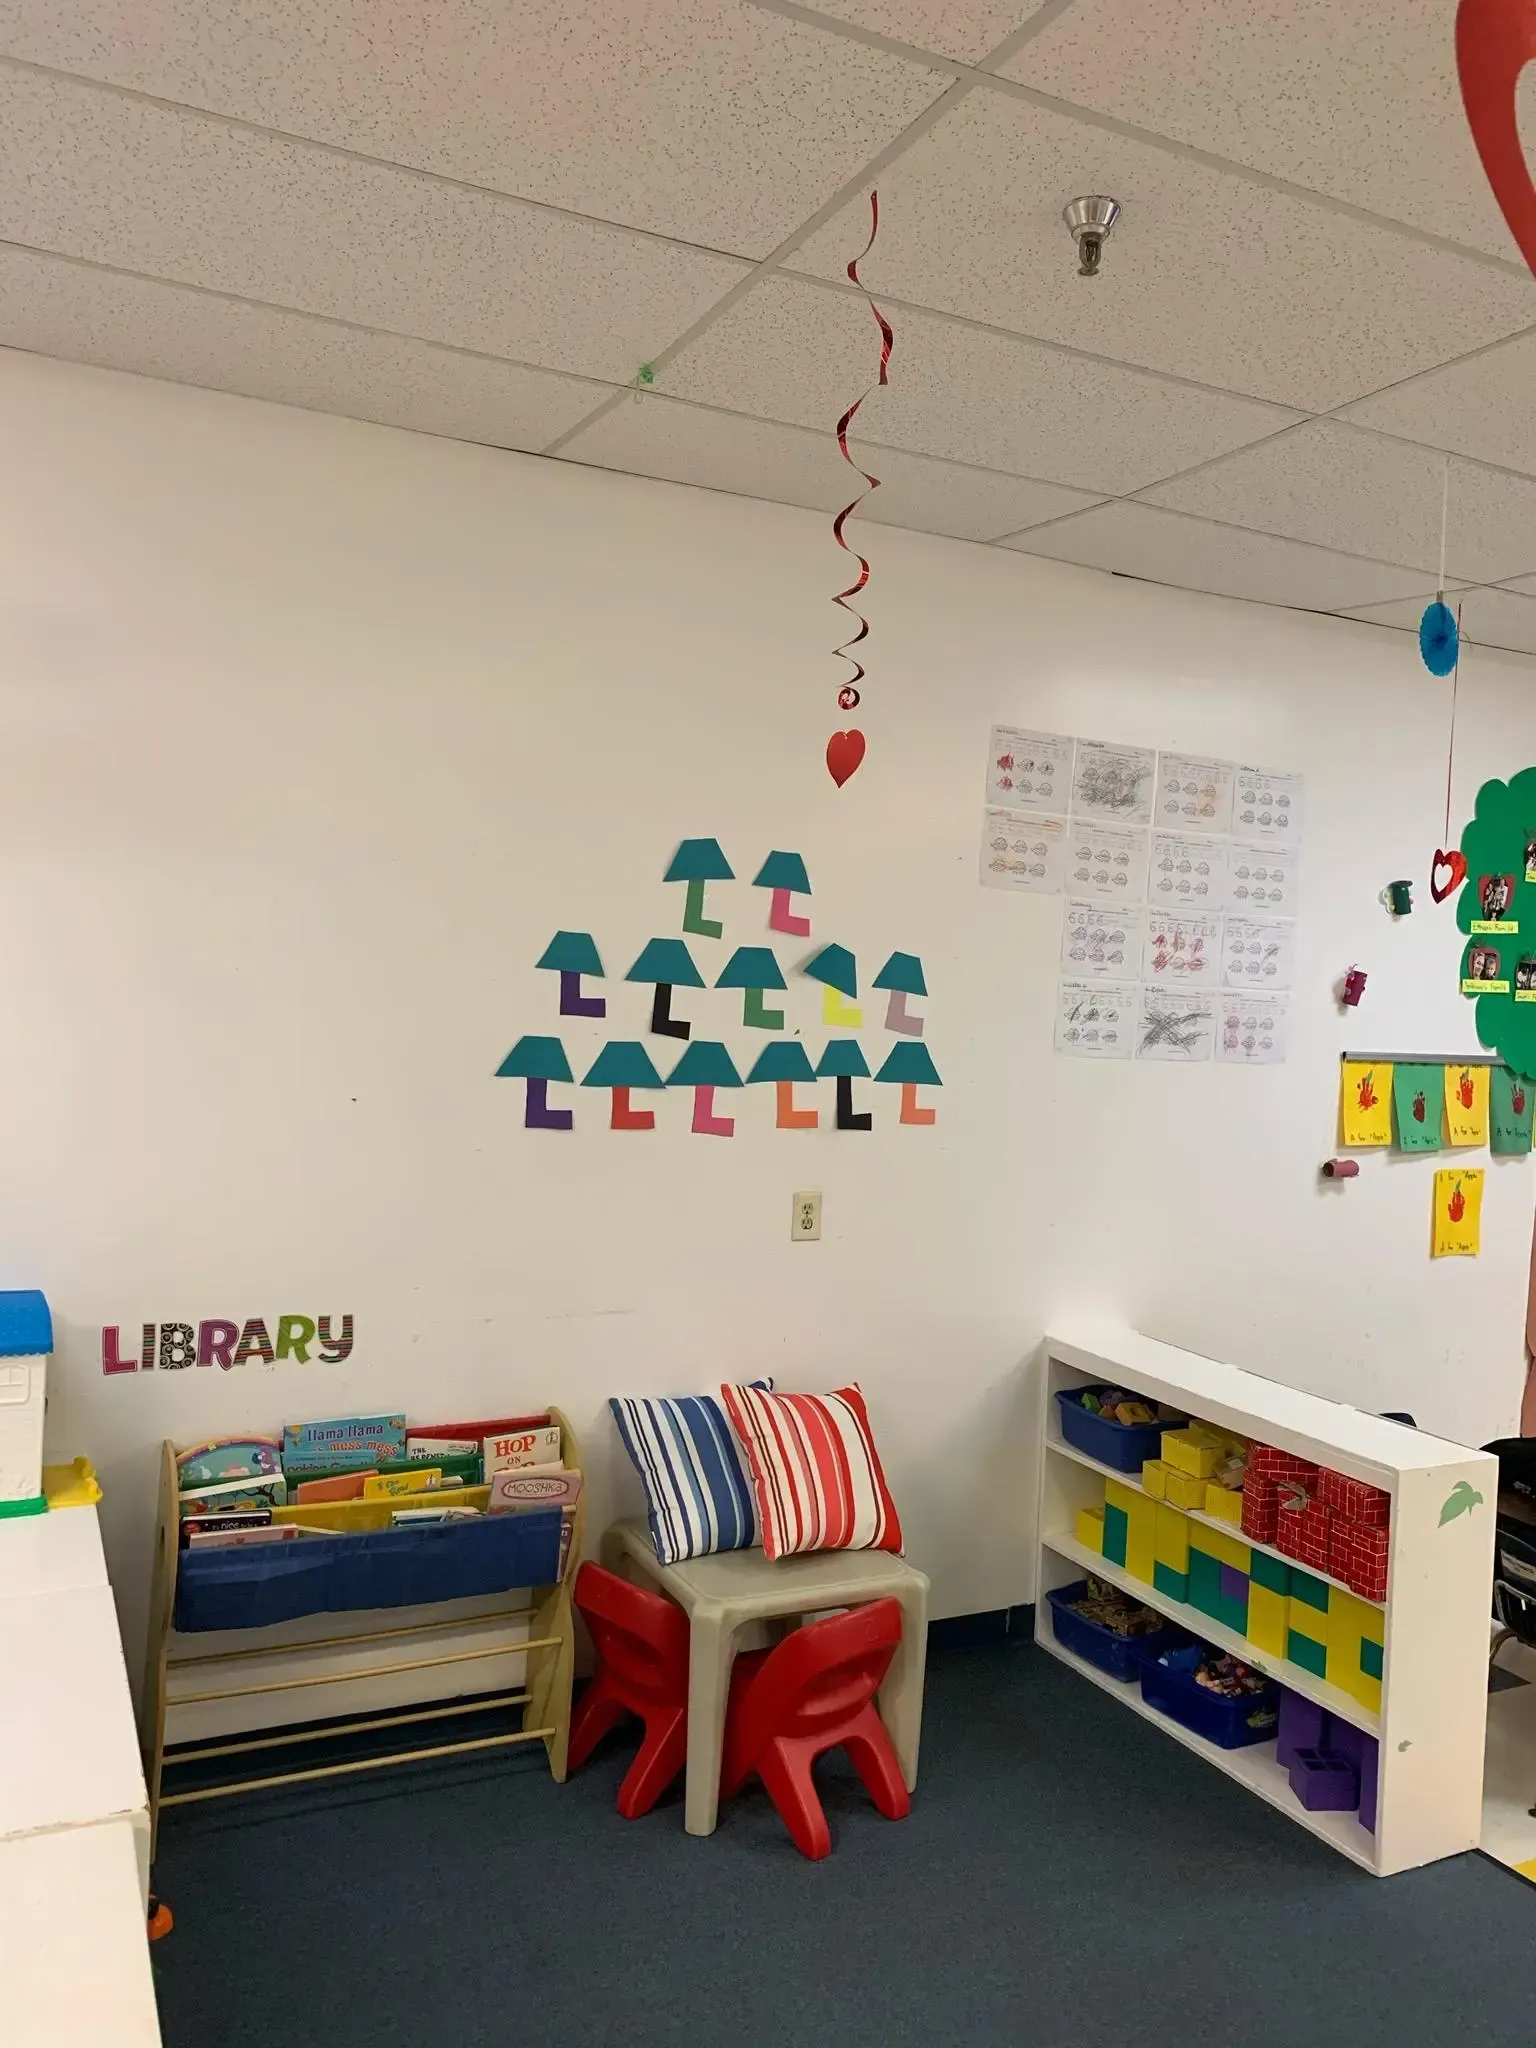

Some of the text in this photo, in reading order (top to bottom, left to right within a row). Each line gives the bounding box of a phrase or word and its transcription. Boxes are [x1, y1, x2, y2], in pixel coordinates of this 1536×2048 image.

[102, 1315, 354, 1375] LIBRARY
[308, 1424, 384, 1441] llama llama
[330, 1440, 398, 1456] mess mess
[494, 1435, 537, 1458] HOP
[507, 1455, 521, 1465] ON
[221, 1521, 239, 1530] nice
